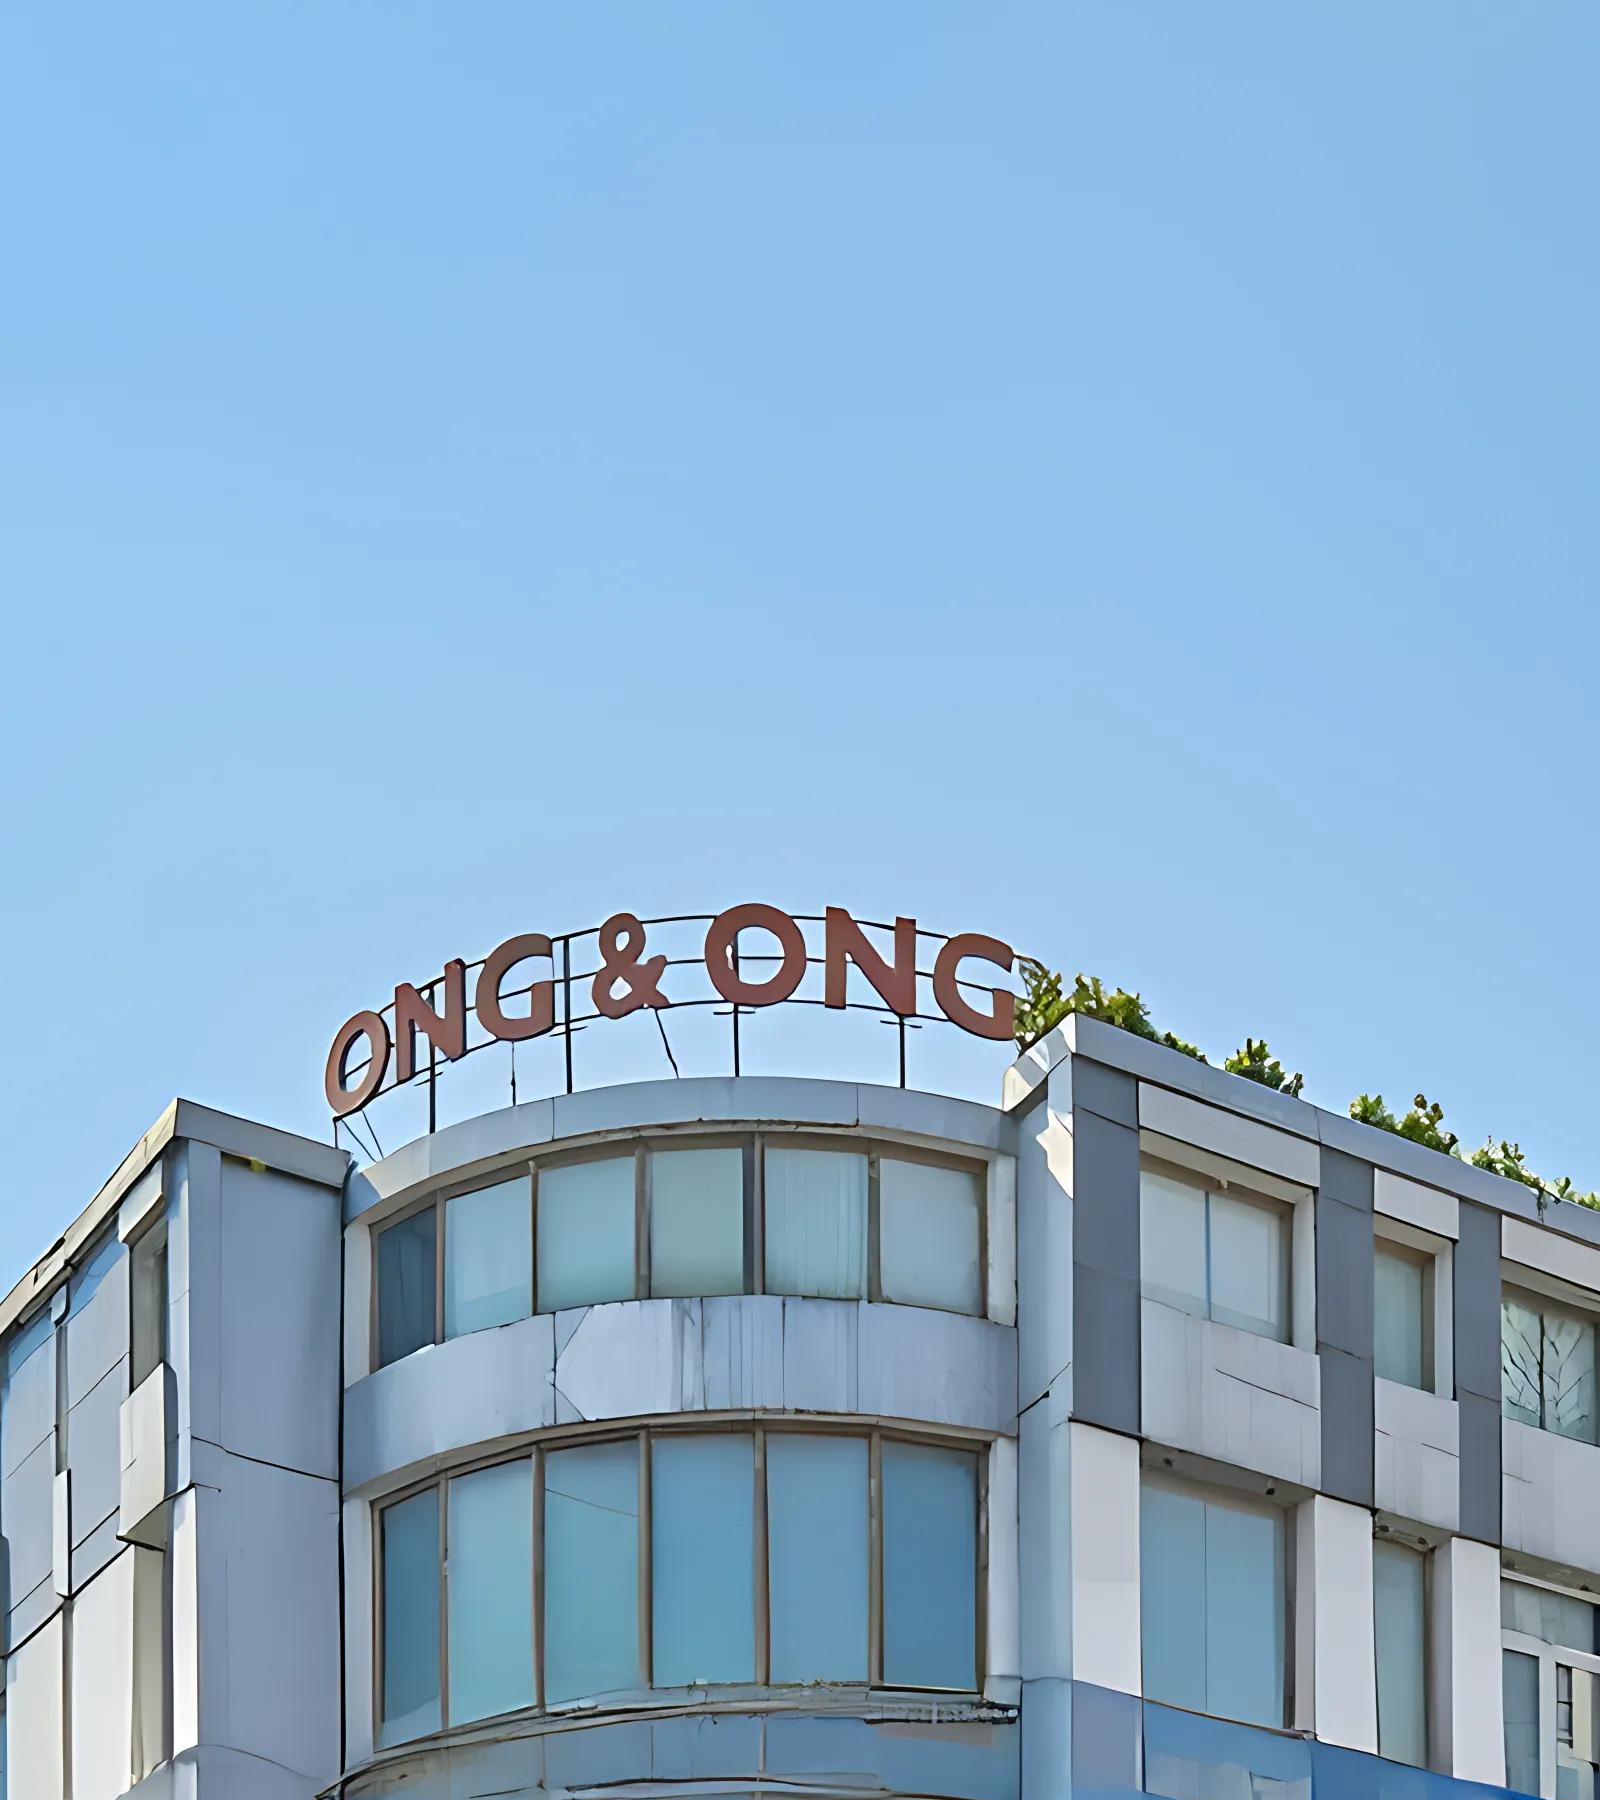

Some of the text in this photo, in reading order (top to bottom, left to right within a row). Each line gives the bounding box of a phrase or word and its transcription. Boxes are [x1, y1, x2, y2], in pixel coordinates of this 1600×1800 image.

[325, 902, 1015, 1117] ONG & ONG
